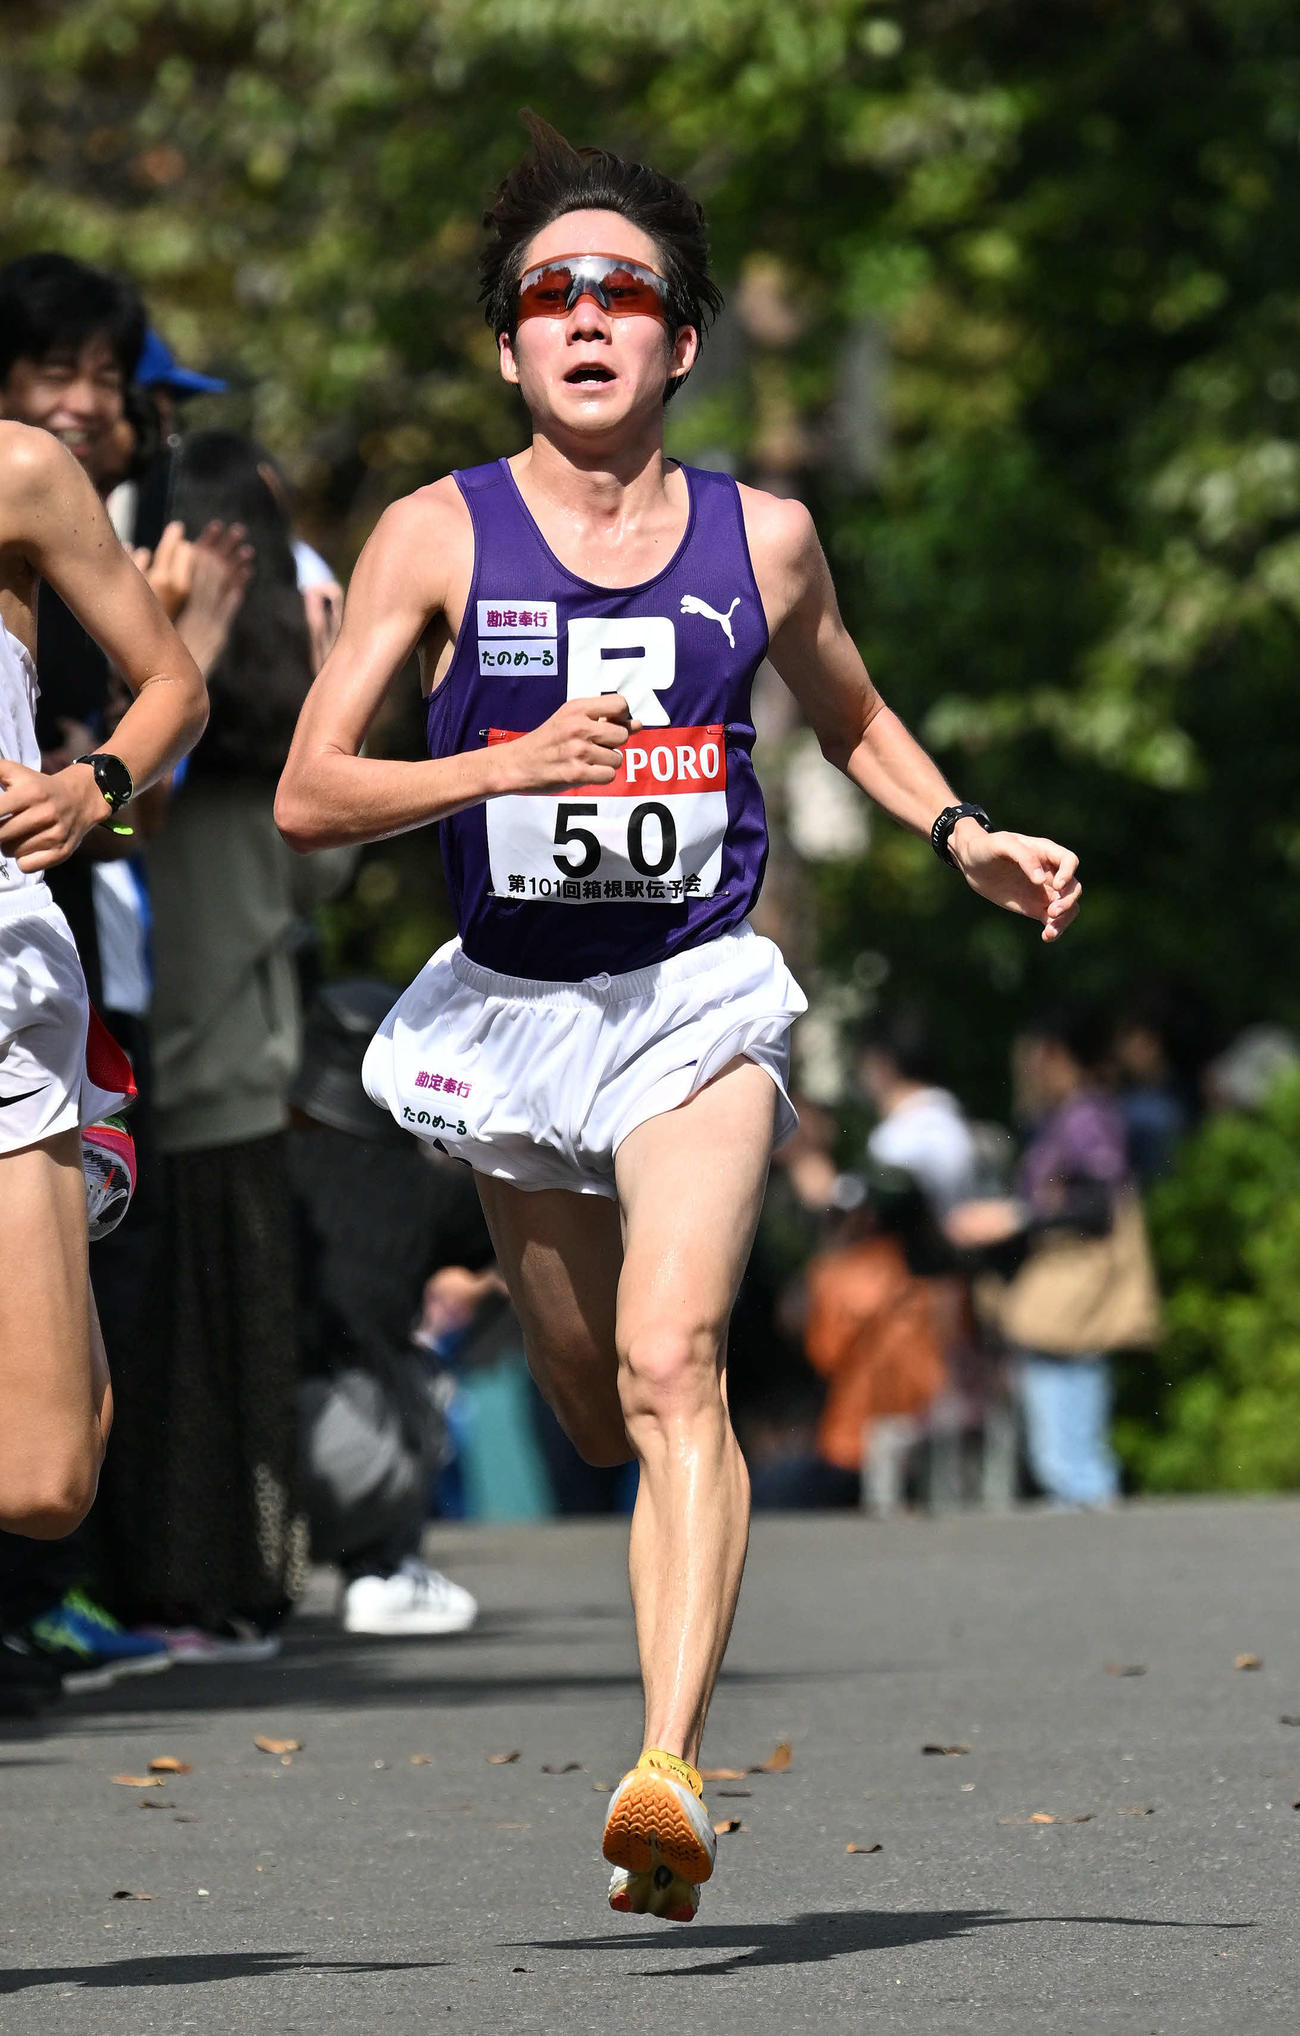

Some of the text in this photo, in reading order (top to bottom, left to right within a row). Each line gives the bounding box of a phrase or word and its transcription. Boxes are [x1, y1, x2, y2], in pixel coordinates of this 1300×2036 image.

[487, 610, 548, 628] 勘定奉行
[482, 650, 554, 666] たのめーる
[567, 617, 675, 726] R
[613, 743, 719, 783] PORO
[508, 873, 702, 900] 第101回箱根駅伝予会
[415, 1071, 472, 1098] 勘定奉行
[403, 1106, 467, 1135] たのめーる
